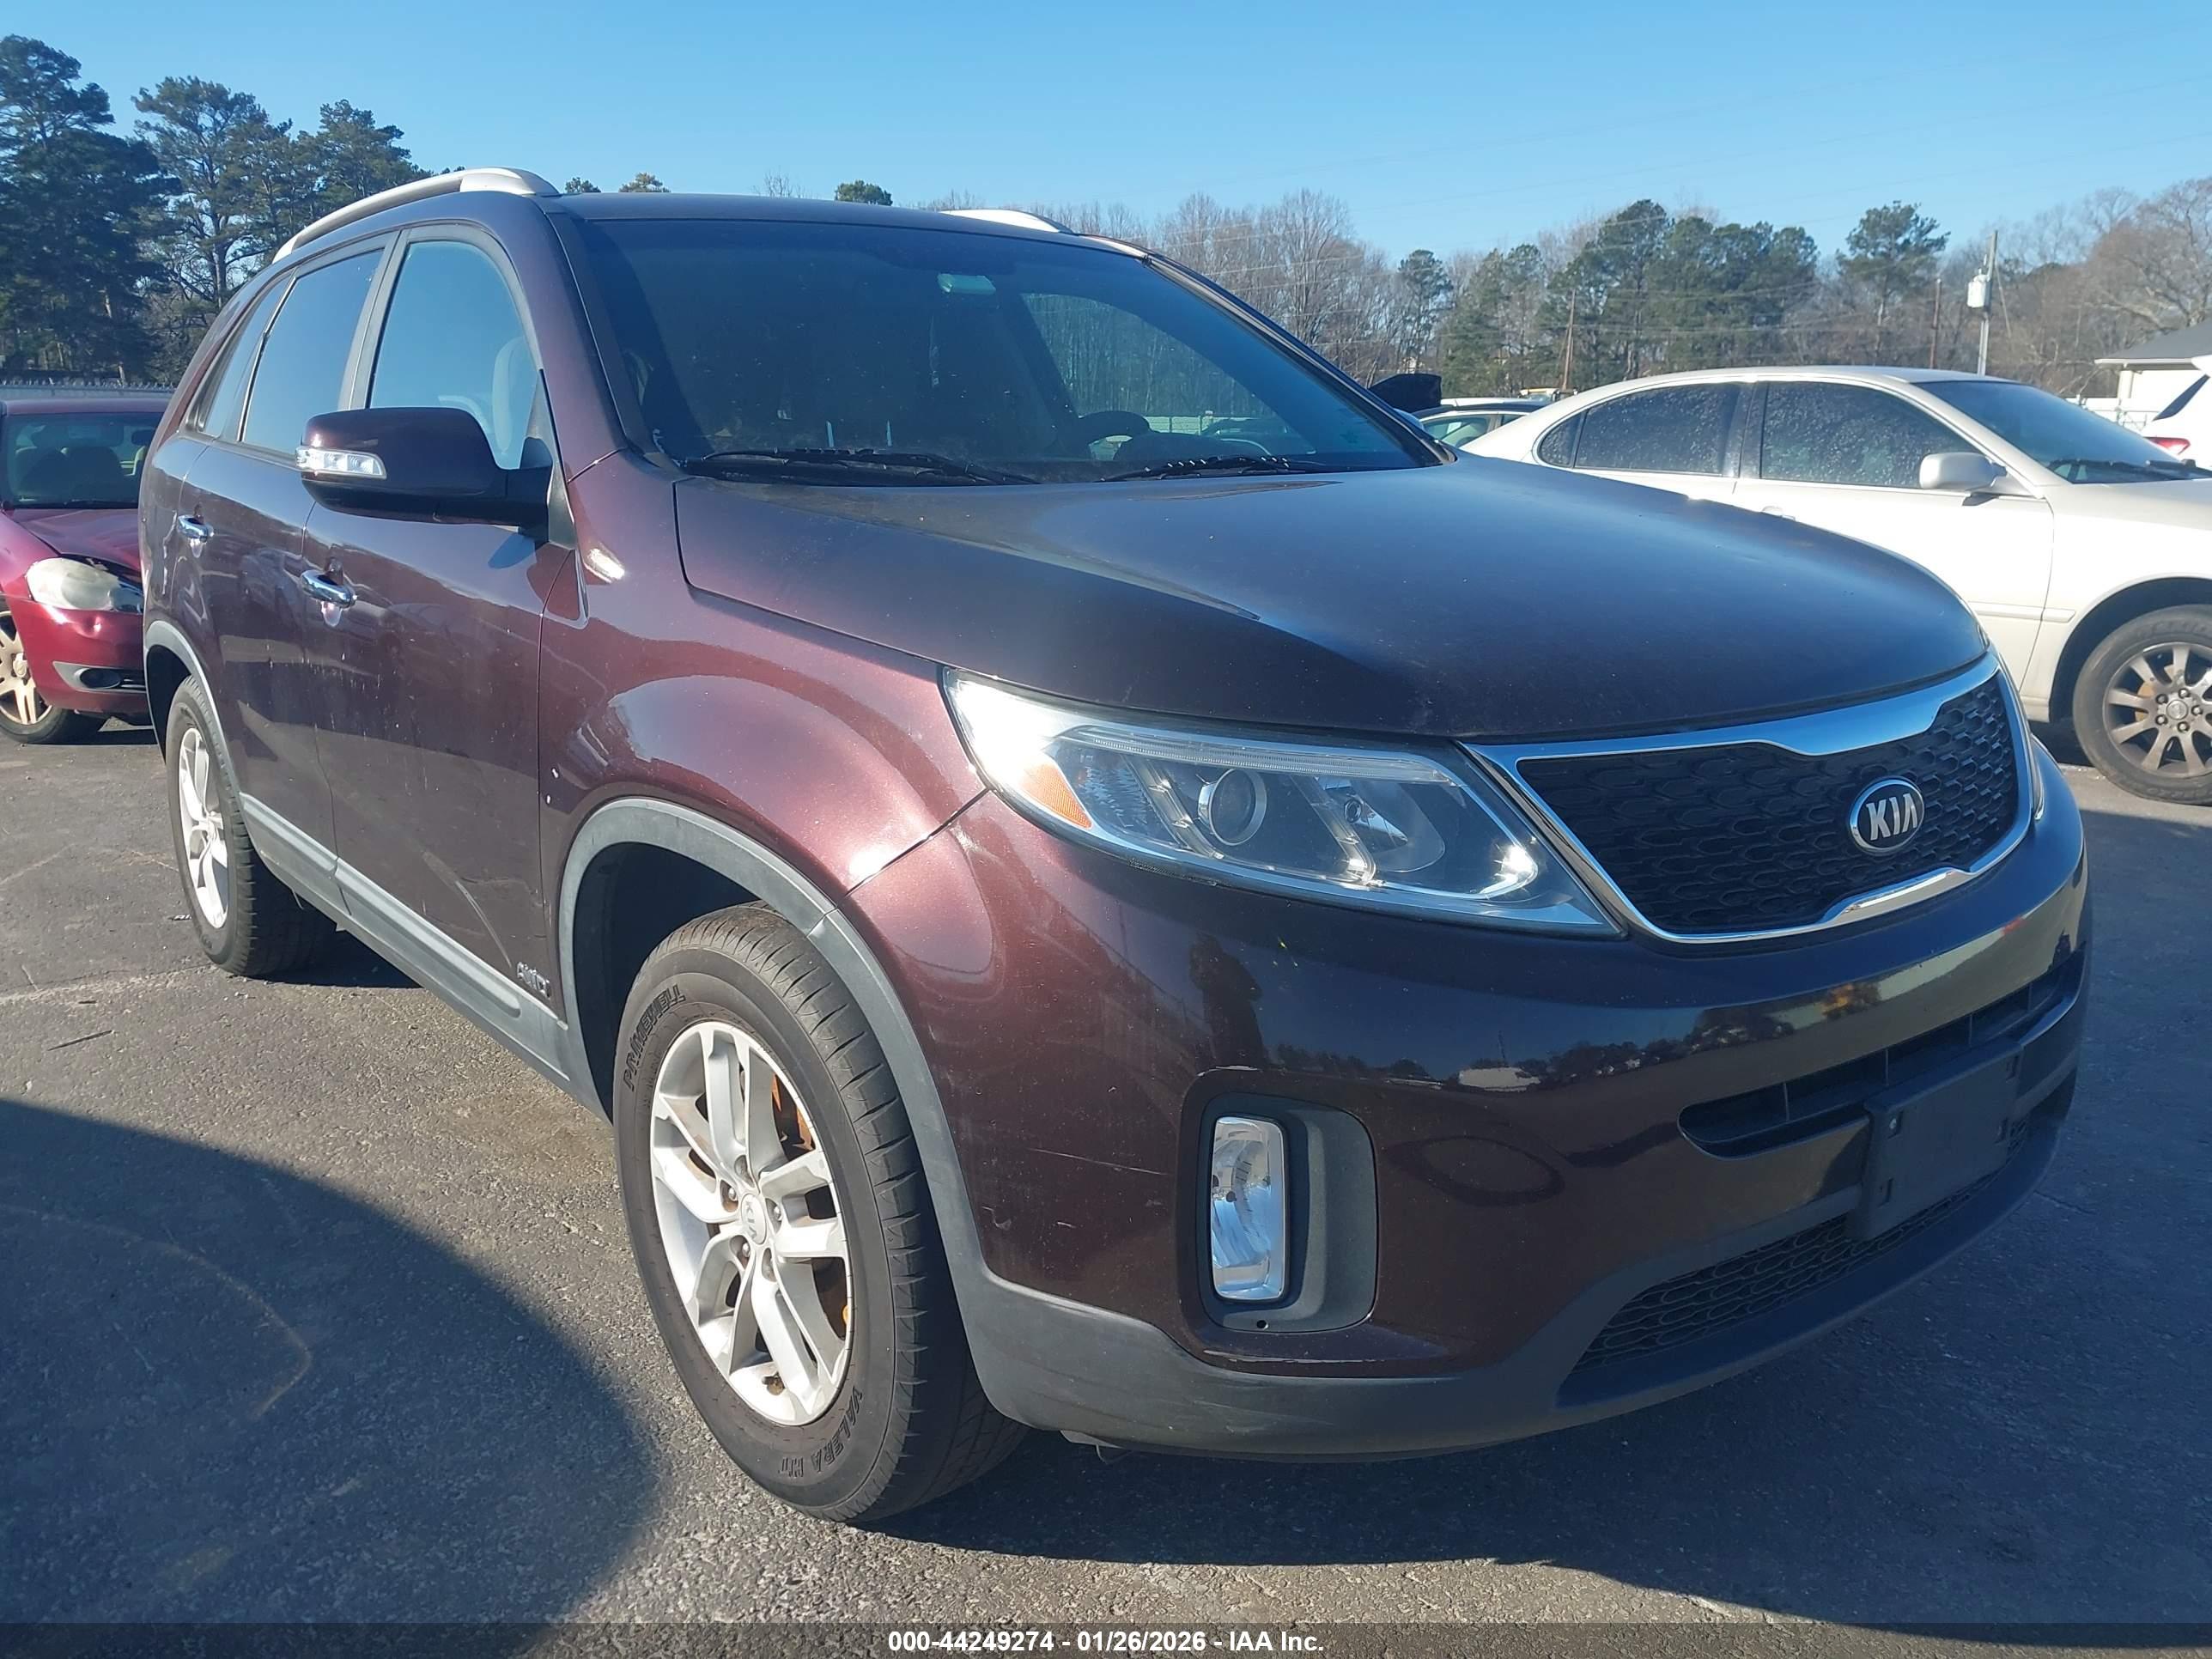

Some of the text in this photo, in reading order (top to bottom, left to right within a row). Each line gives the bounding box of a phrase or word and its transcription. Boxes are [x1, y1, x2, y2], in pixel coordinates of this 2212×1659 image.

[1866, 793, 1918, 842] KIA
[623, 983, 686, 1092] PRIMEWELL
[811, 1385, 863, 1474] VALERA
